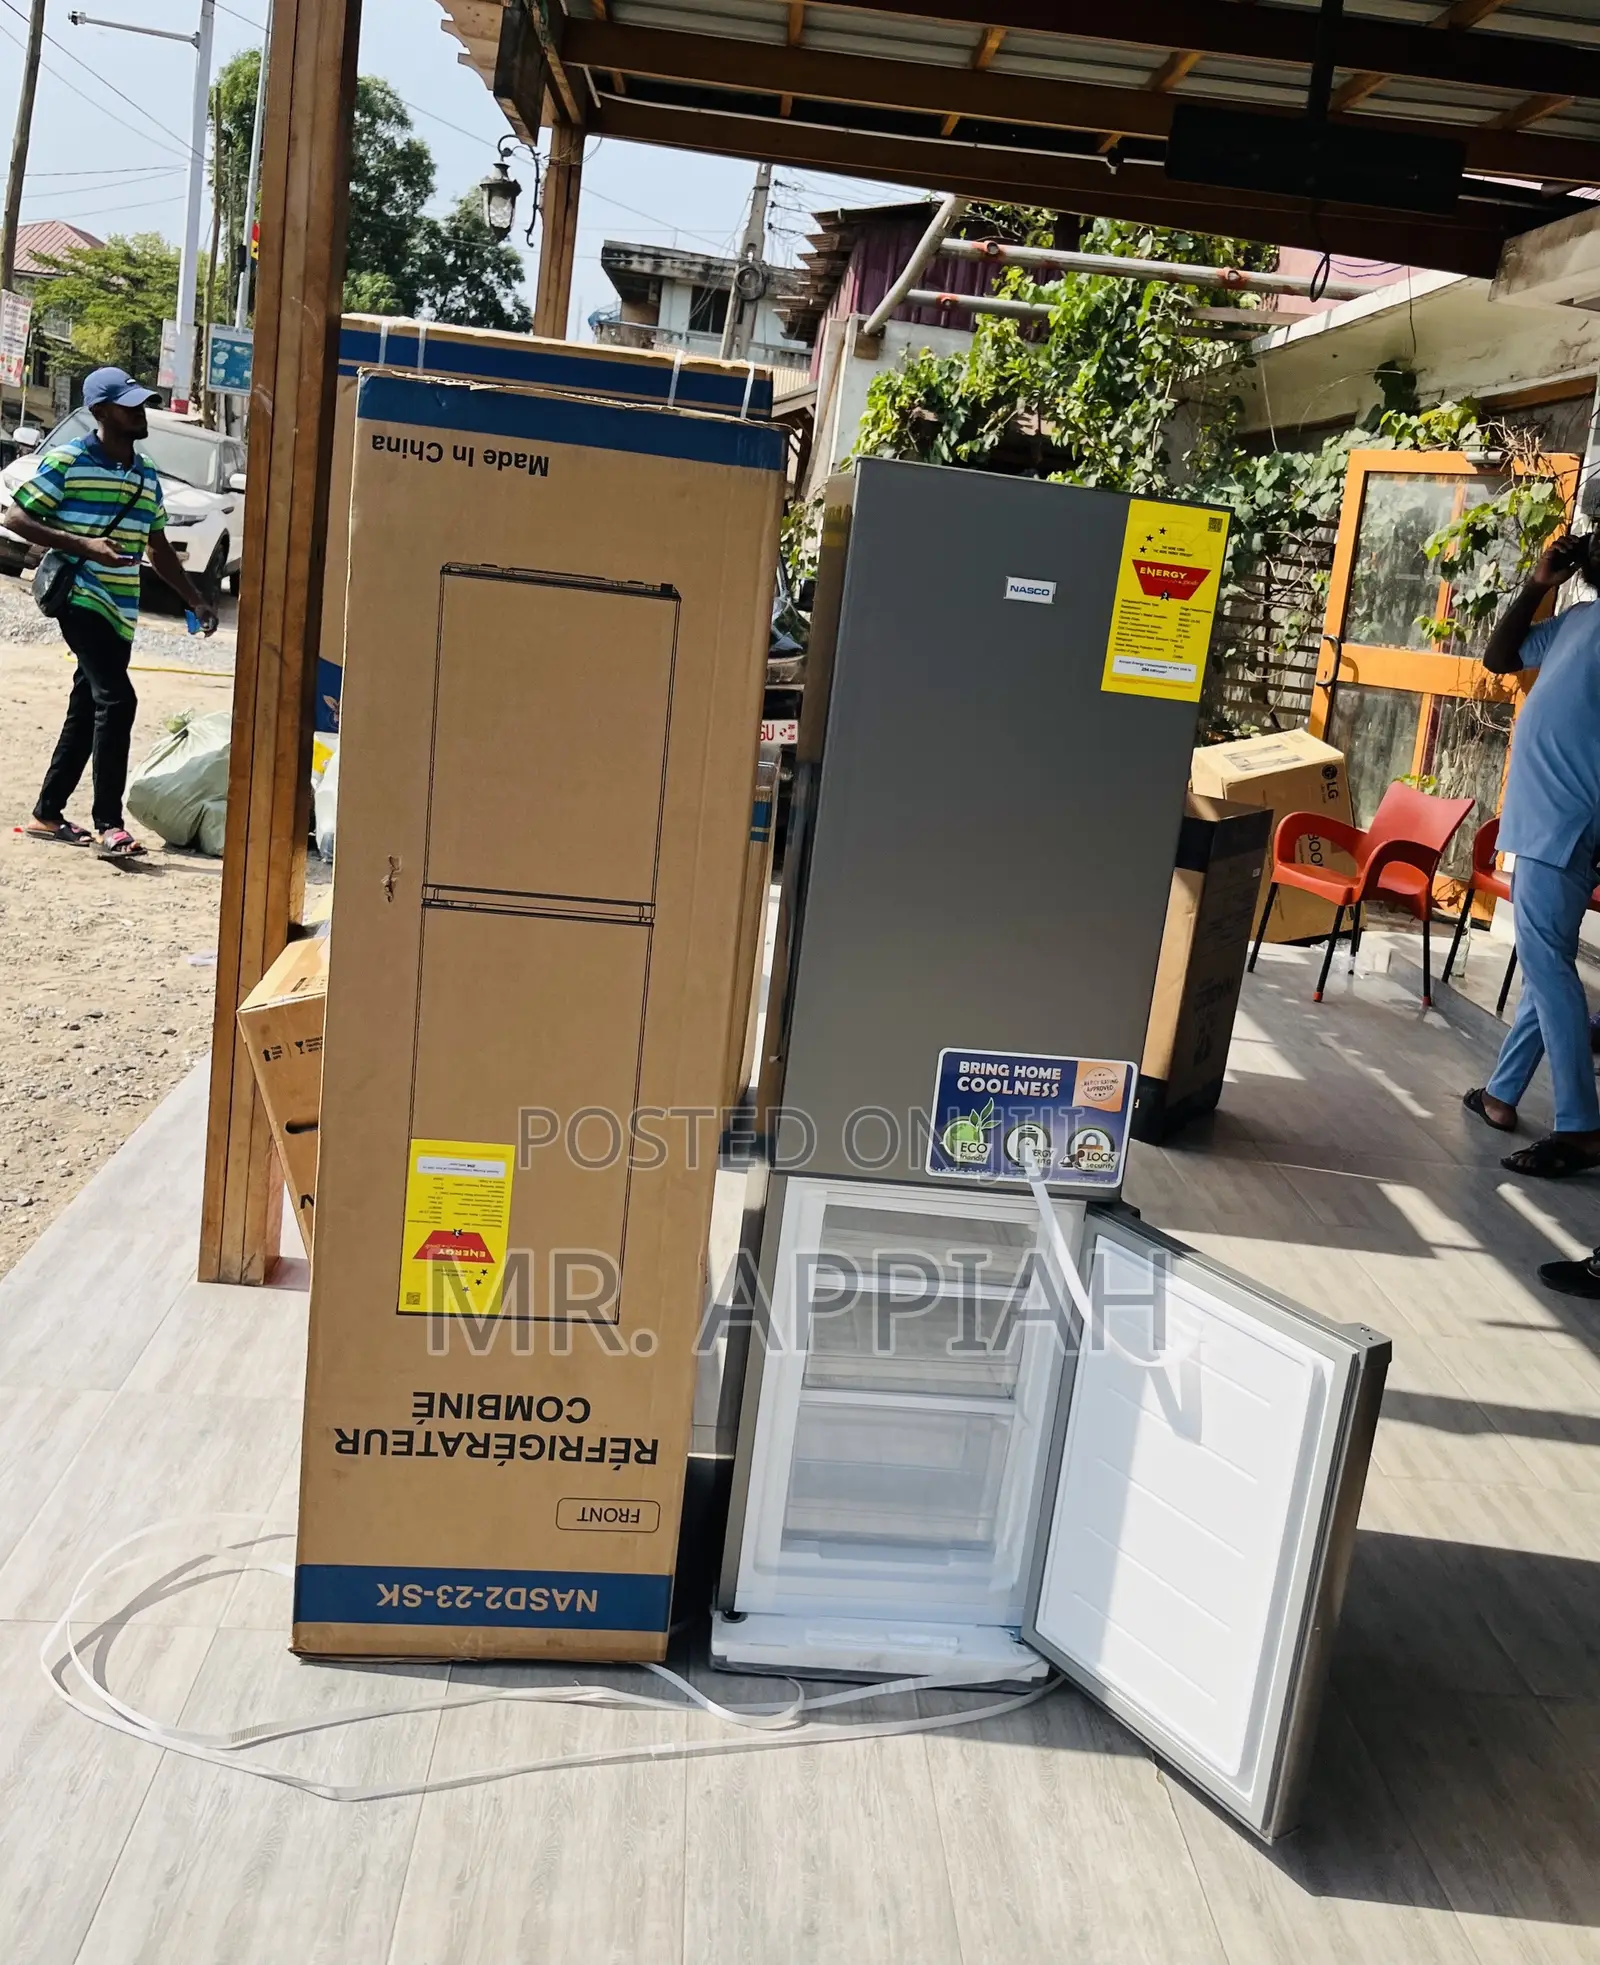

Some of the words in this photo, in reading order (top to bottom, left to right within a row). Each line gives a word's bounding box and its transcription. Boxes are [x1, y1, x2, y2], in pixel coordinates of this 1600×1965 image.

[372, 435, 443, 463] China
[453, 445, 474, 467] In
[483, 449, 549, 477] Made
[1140, 566, 1187, 580] ENERGY
[1010, 585, 1050, 596] NASCO
[1327, 781, 1338, 799] LG
[959, 1061, 1010, 1077] BRING
[1013, 1065, 1062, 1080] HOME
[957, 1076, 1059, 1098] COOLNESS
[960, 1142, 988, 1154] ECO
[1086, 1152, 1115, 1162] LOCK
[959, 1153, 987, 1162] friendly
[1086, 1161, 1115, 1170] security
[412, 1391, 591, 1425] COMBINÉ
[333, 1428, 659, 1470] RÉFRIGÉRATEUR
[577, 1506, 641, 1524] FRONT
[376, 1583, 598, 1612] NASD2-23-SK
